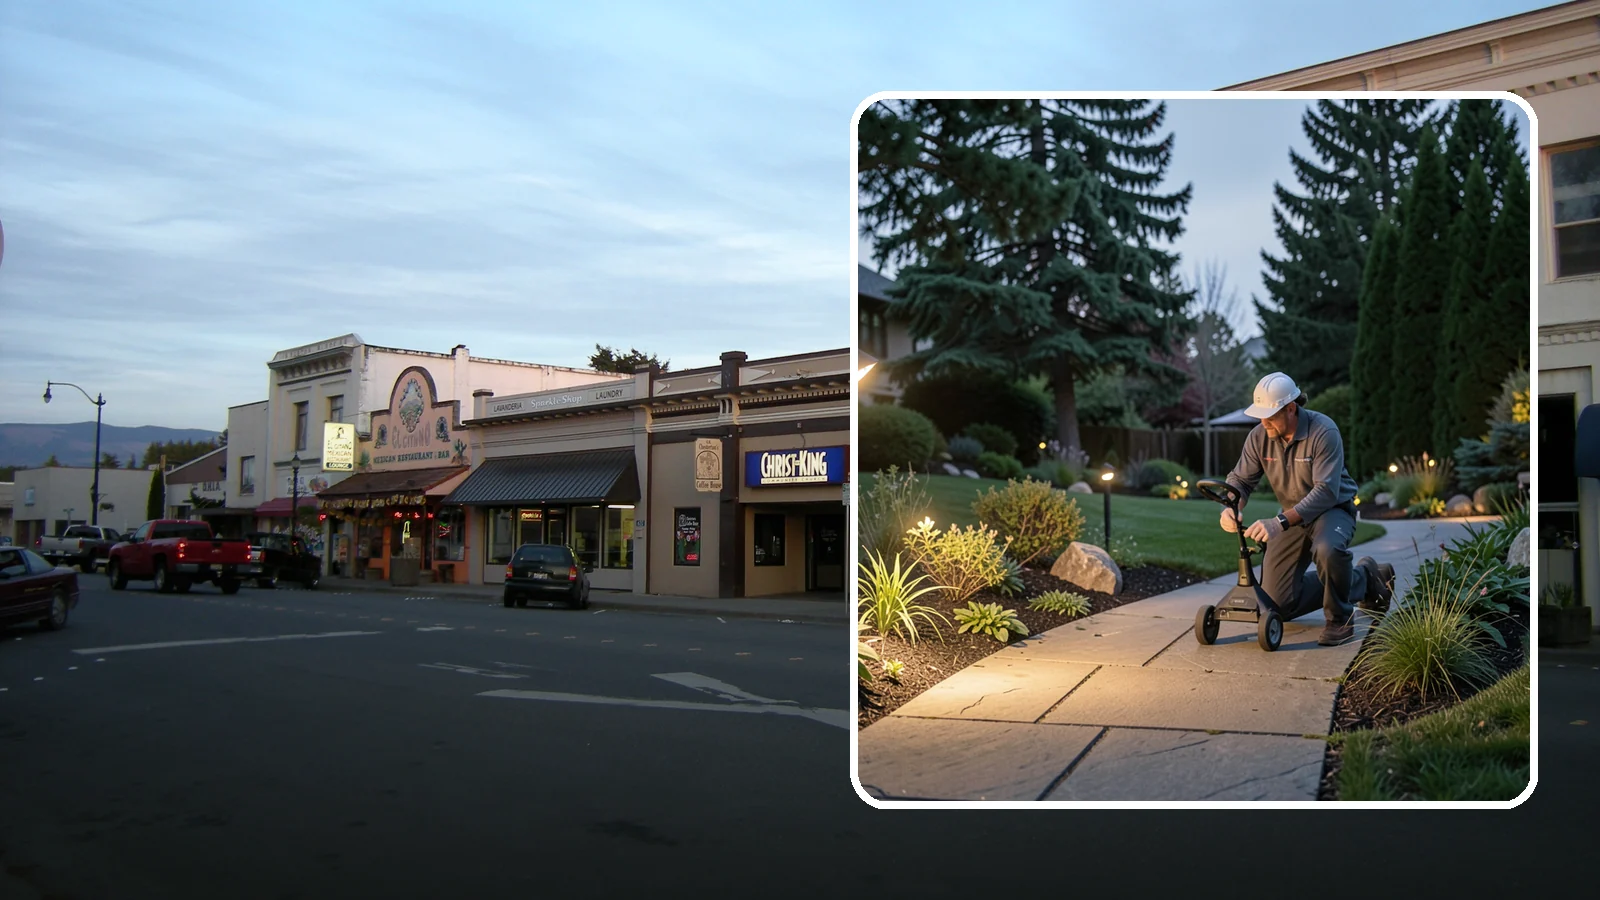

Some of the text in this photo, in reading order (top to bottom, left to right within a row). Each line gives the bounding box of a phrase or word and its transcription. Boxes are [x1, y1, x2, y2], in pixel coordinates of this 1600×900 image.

[493, 402, 523, 413] LAVANDERIA
[562, 394, 582, 405] Shop
[595, 389, 624, 400] LAUNDRY
[373, 455, 396, 464] MEXICAN
[397, 451, 433, 463] RESTAURANT
[438, 450, 450, 459] BAR
[761, 450, 827, 478] CHRIST KING
